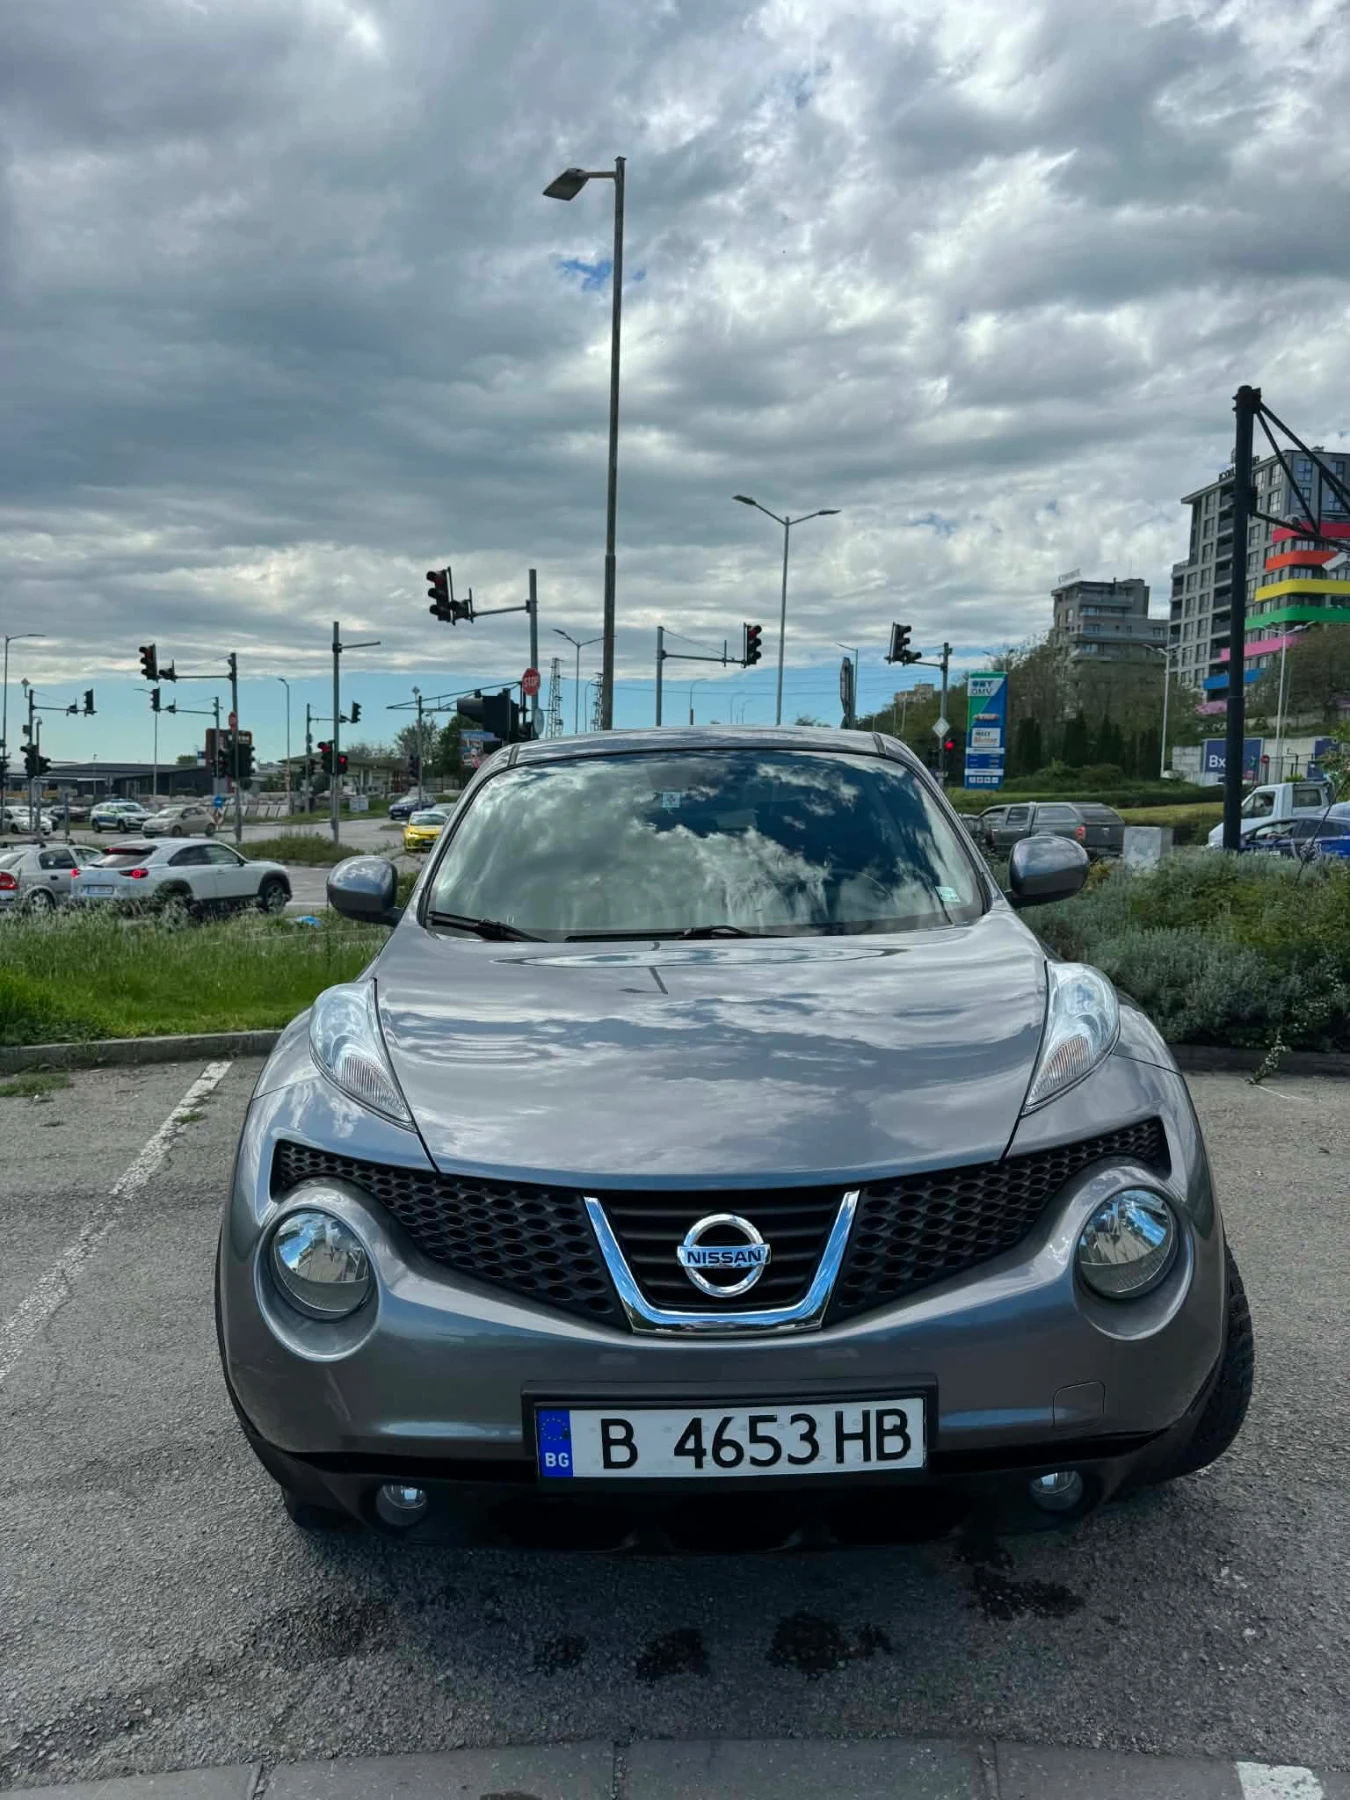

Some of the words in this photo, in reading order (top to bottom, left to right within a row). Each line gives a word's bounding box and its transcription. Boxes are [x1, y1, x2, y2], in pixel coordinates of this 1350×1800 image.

[523, 676, 539, 689] STOP
[687, 1250, 761, 1264] NISSAN
[601, 1418, 638, 1469] B
[674, 1413, 820, 1468] 4653
[835, 1408, 911, 1463] HB
[545, 1452, 569, 1467] BG
